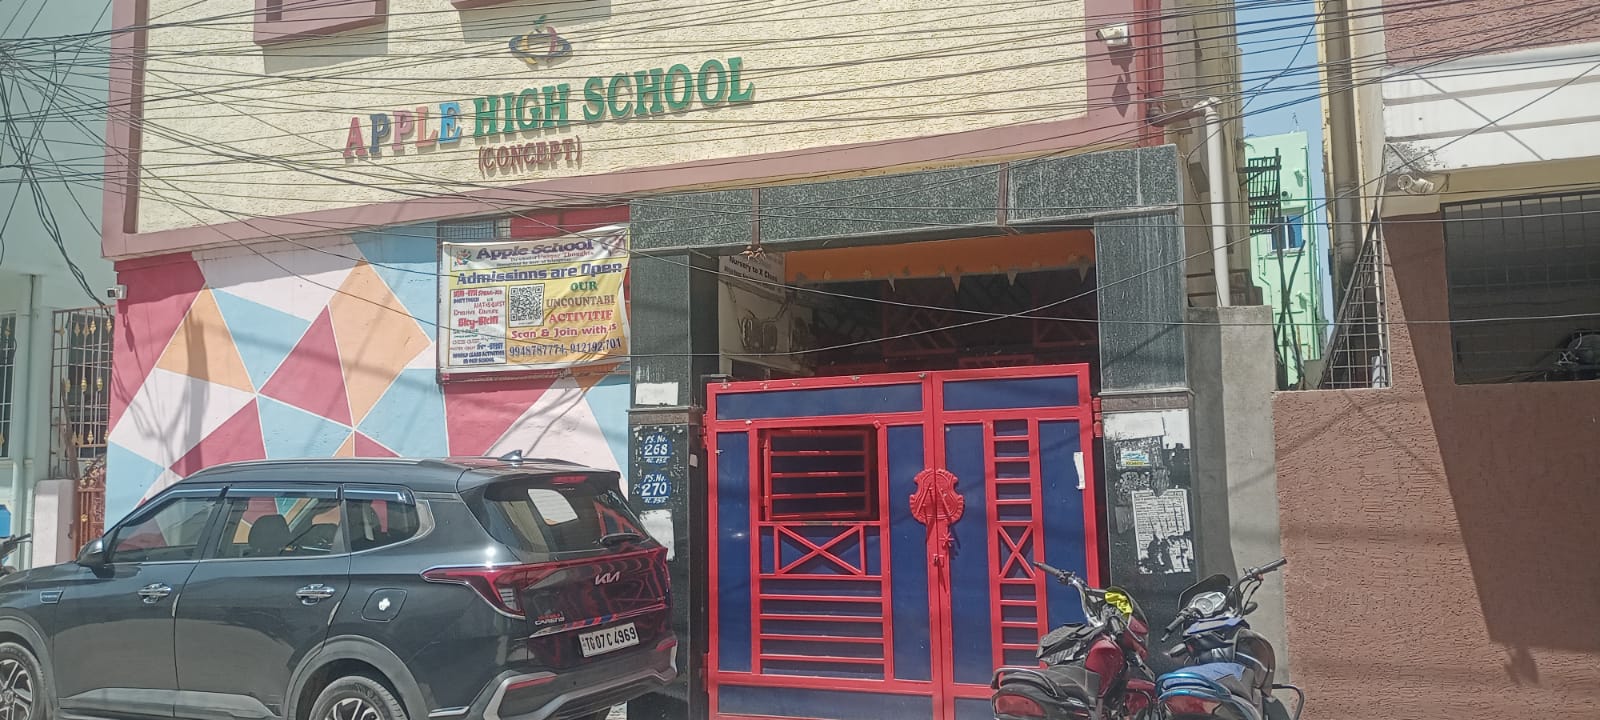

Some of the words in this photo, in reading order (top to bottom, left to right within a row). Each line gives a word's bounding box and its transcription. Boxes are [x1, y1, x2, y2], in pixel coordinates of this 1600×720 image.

[343, 101, 463, 159] APPLE
[472, 83, 570, 138] HIGH
[582, 56, 754, 122] SCHOOL
[478, 136, 583, 175] (CONCEPT)
[476, 245, 528, 260] Apple
[531, 239, 594, 254] School
[550, 265, 579, 279] are
[752, 266, 758, 274] to
[571, 280, 598, 292] OUR
[511, 330, 537, 339] Scan
[541, 328, 550, 337] &
[554, 327, 577, 338] Join
[582, 325, 607, 335] with
[644, 444, 668, 456] 268
[641, 482, 667, 497] 270
[595, 570, 621, 585] KIA
[585, 633, 595, 651] TG
[597, 634, 606, 649] 07
[607, 632, 613, 647] C
[614, 626, 636, 645] 4969
